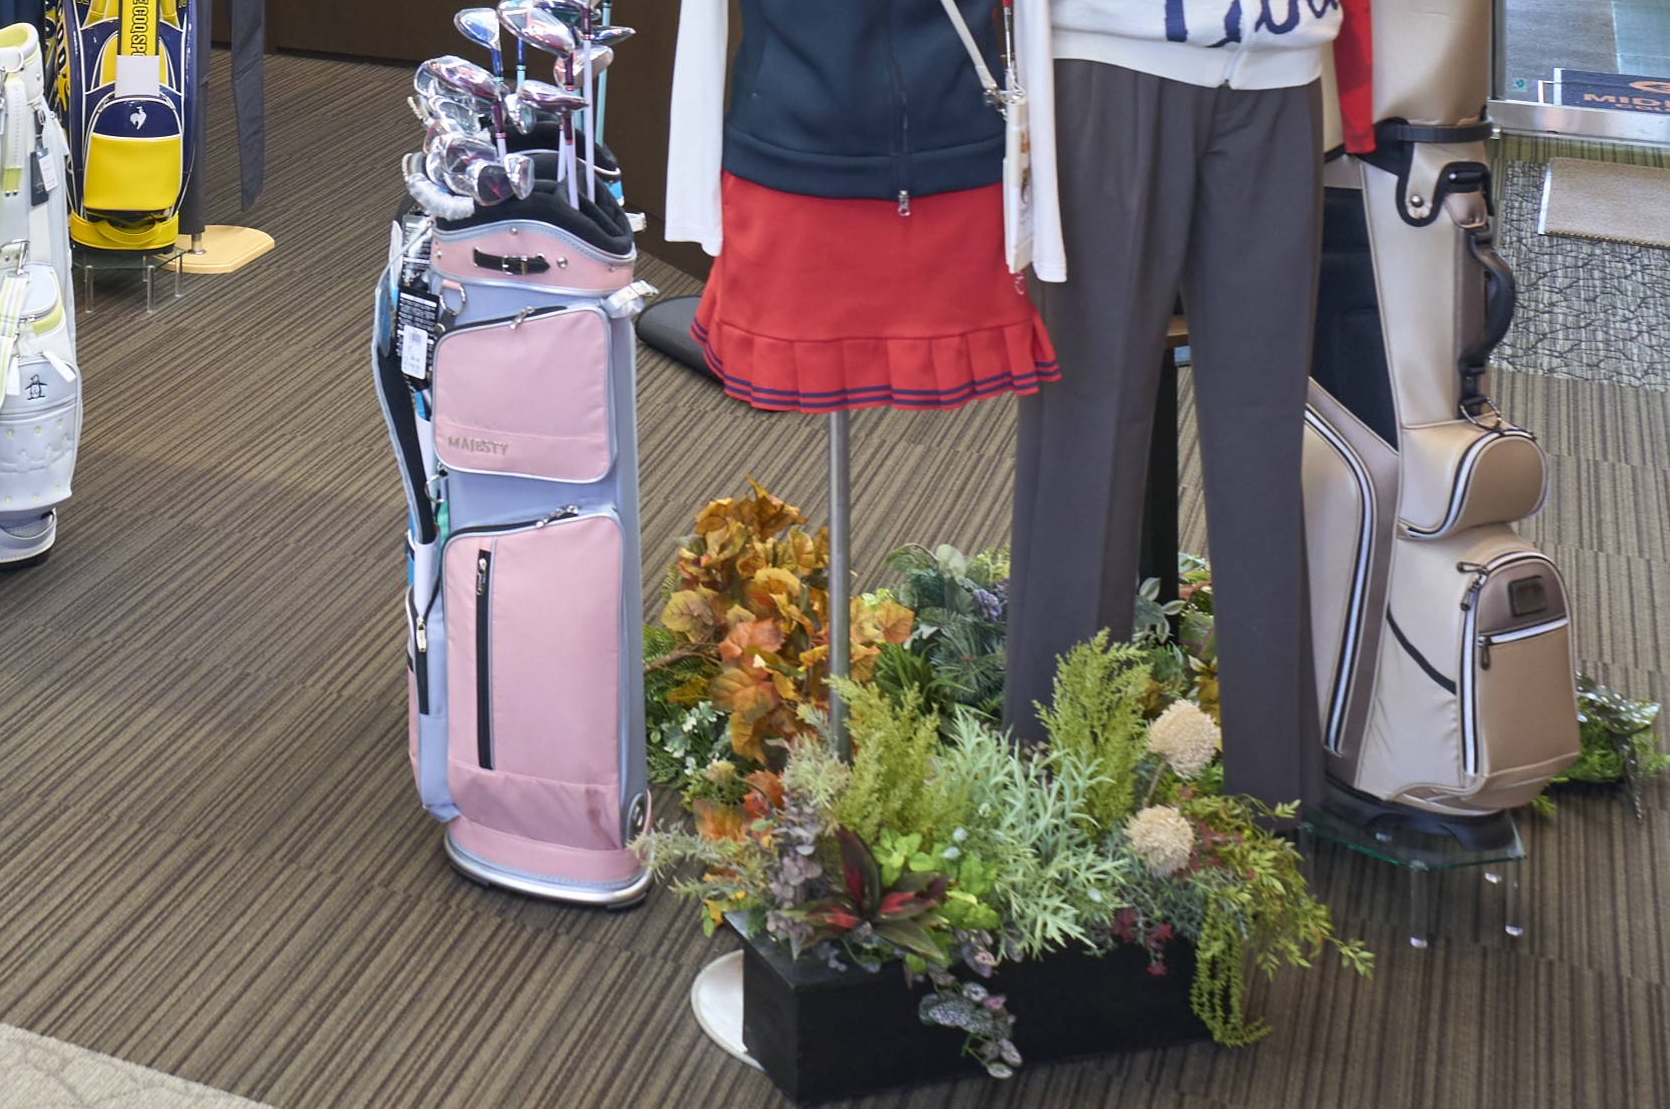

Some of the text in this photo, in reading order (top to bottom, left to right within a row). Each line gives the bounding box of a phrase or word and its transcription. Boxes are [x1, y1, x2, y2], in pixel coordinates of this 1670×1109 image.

[130, 6, 150, 34] COQ
[1582, 93, 1670, 109] MID
[448, 436, 508, 455] MAJESTY
